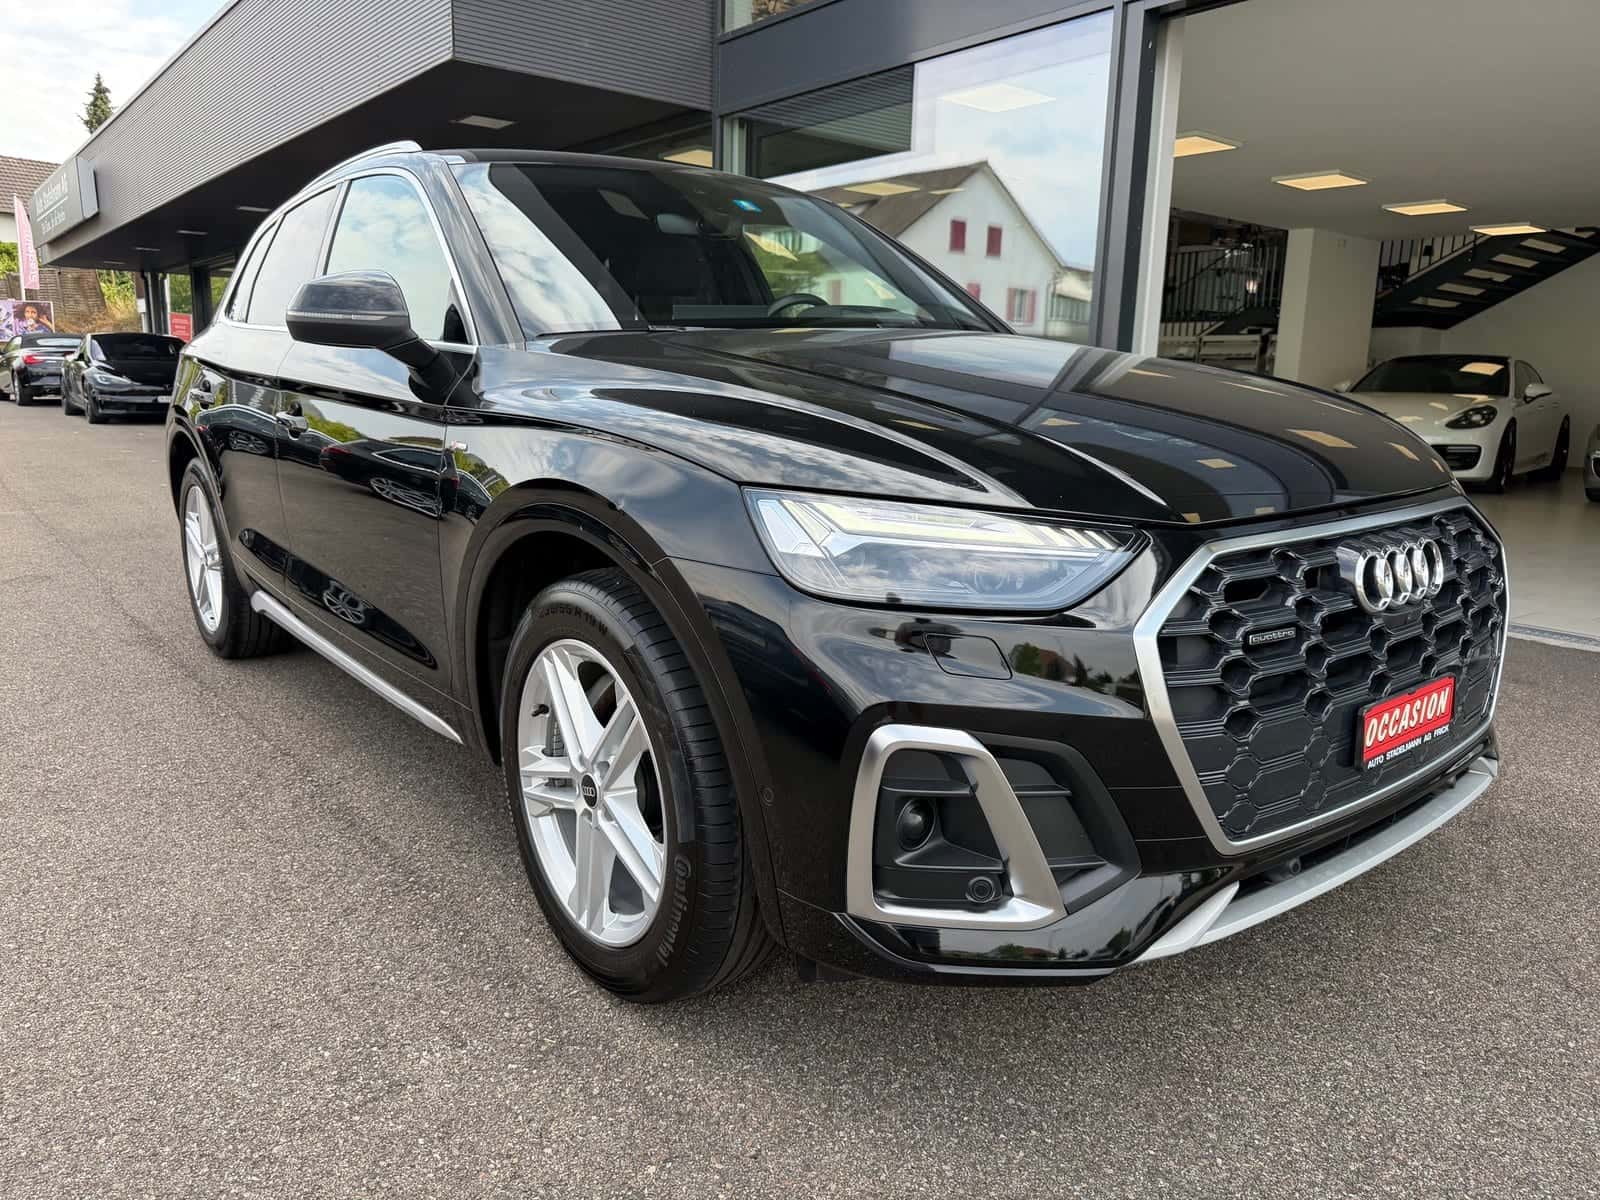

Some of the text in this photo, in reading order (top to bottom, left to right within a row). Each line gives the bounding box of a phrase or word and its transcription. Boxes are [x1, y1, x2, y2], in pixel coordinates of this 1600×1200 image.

[1252, 629, 1295, 644] quattro
[1366, 687, 1450, 746] OCCASION
[1368, 724, 1450, 769] AUTO STADELMANN AG FRICK
